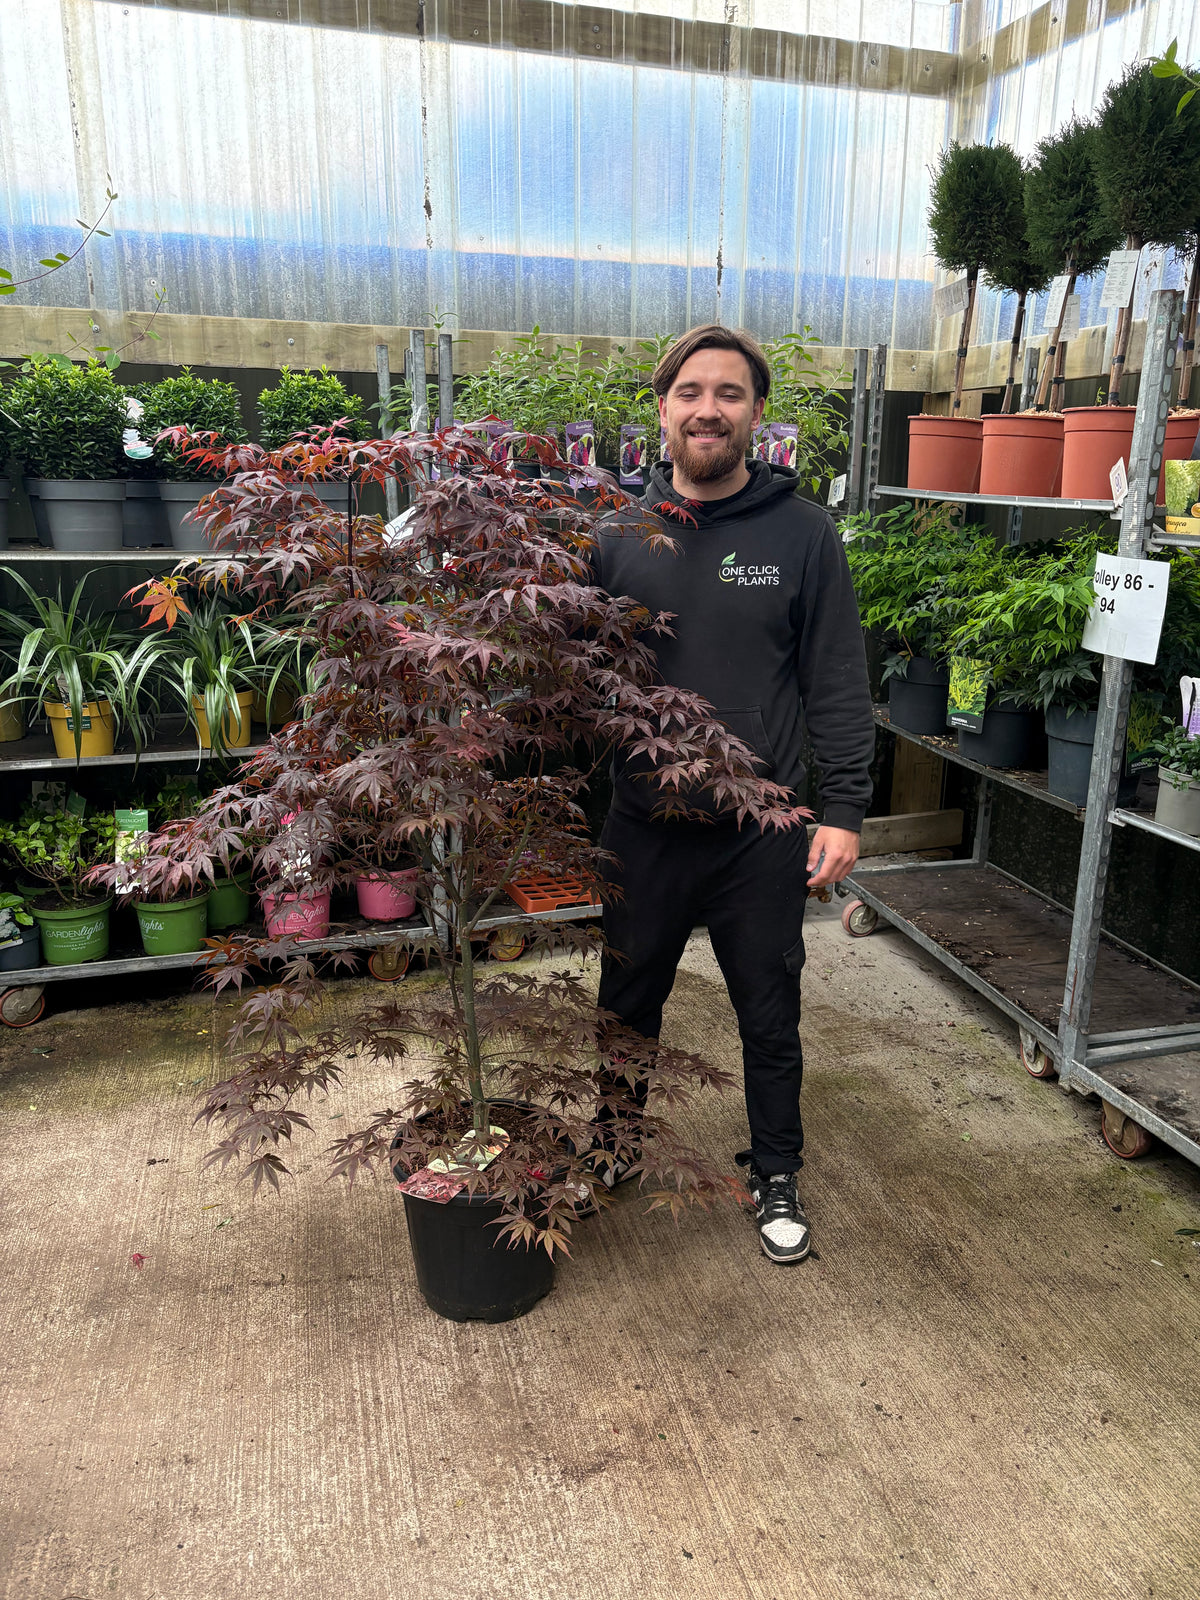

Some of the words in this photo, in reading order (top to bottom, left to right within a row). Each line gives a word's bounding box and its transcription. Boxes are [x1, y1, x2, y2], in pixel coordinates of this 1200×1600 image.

[722, 566, 746, 577] ONE
[747, 565, 780, 575] CLICK
[737, 576, 780, 586] PLANTS
[1123, 573, 1143, 591] 86
[1099, 597, 1115, 614] 94
